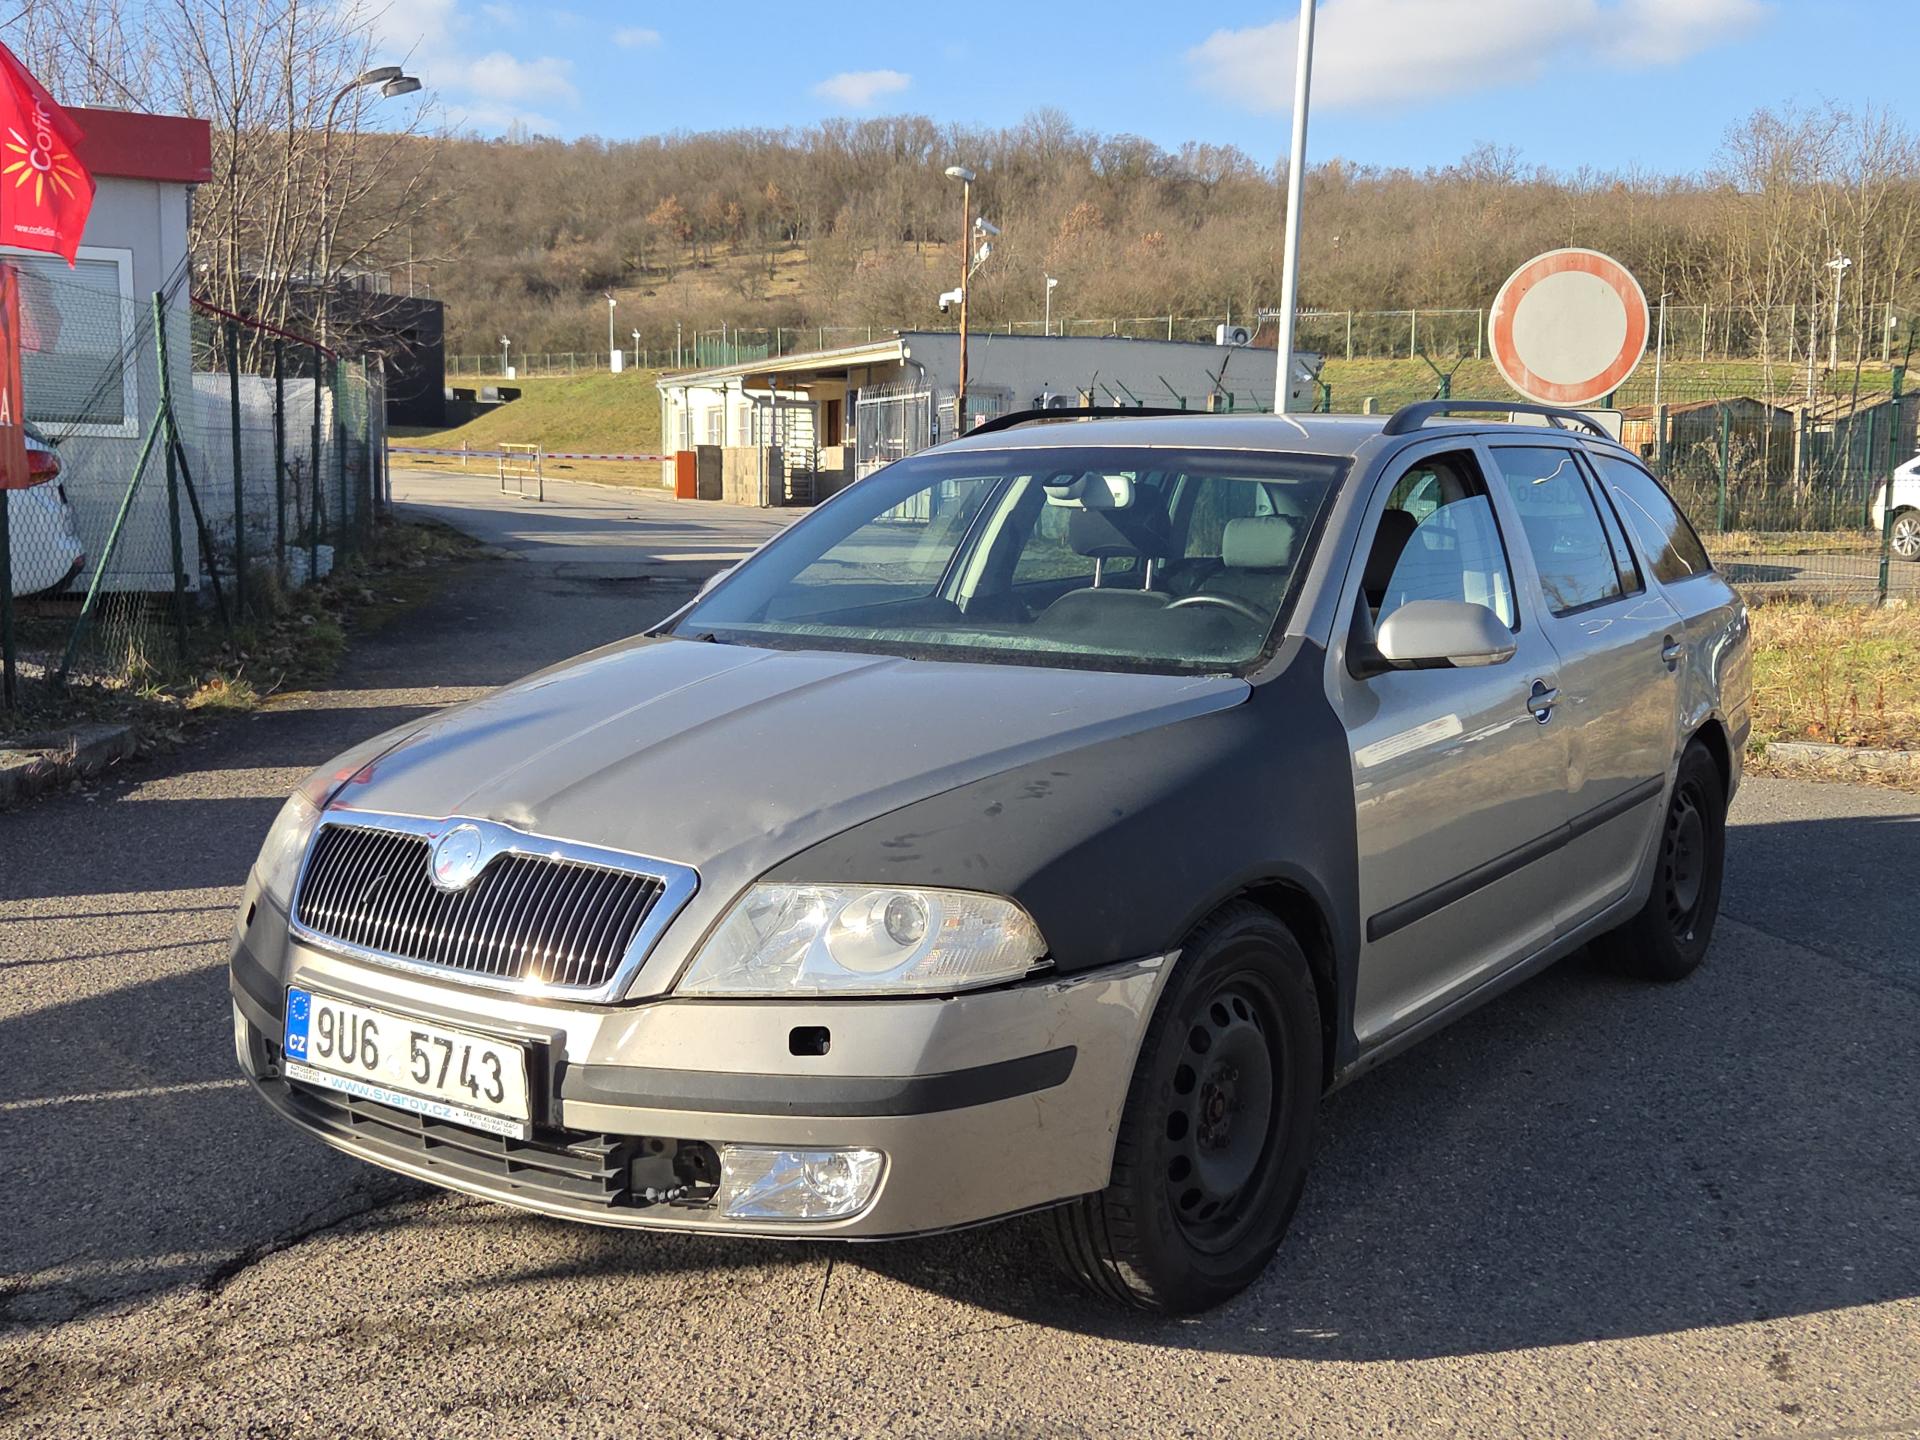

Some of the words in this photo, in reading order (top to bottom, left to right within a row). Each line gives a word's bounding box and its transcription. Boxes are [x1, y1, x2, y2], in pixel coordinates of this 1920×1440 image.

[289, 1033, 306, 1053] CZ
[316, 1006, 379, 1070] 9U6
[410, 1030, 504, 1104] 5743
[331, 1077, 451, 1118] www.svarov.cz
